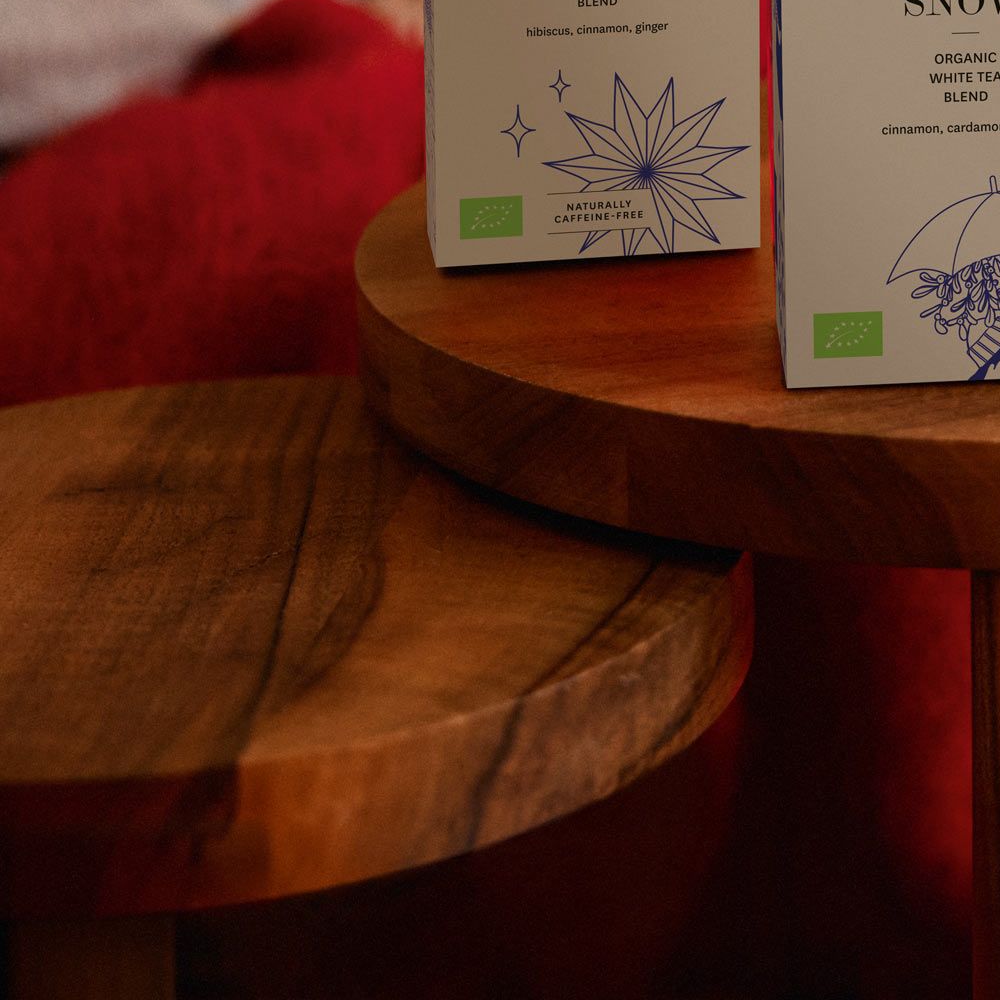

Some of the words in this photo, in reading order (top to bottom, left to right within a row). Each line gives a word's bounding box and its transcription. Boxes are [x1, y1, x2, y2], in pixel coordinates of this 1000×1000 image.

[526, 24, 574, 37] hibiscus,
[577, 23, 632, 35] cinnamon,
[635, 21, 668, 35] ginger
[934, 52, 997, 65] ORGANIC
[929, 72, 973, 84] WHITE
[944, 91, 988, 103] BLEND
[882, 121, 943, 136] cinnamon,
[567, 200, 631, 212] NATURALLY
[554, 211, 644, 224] CAFFEINE-FREE
